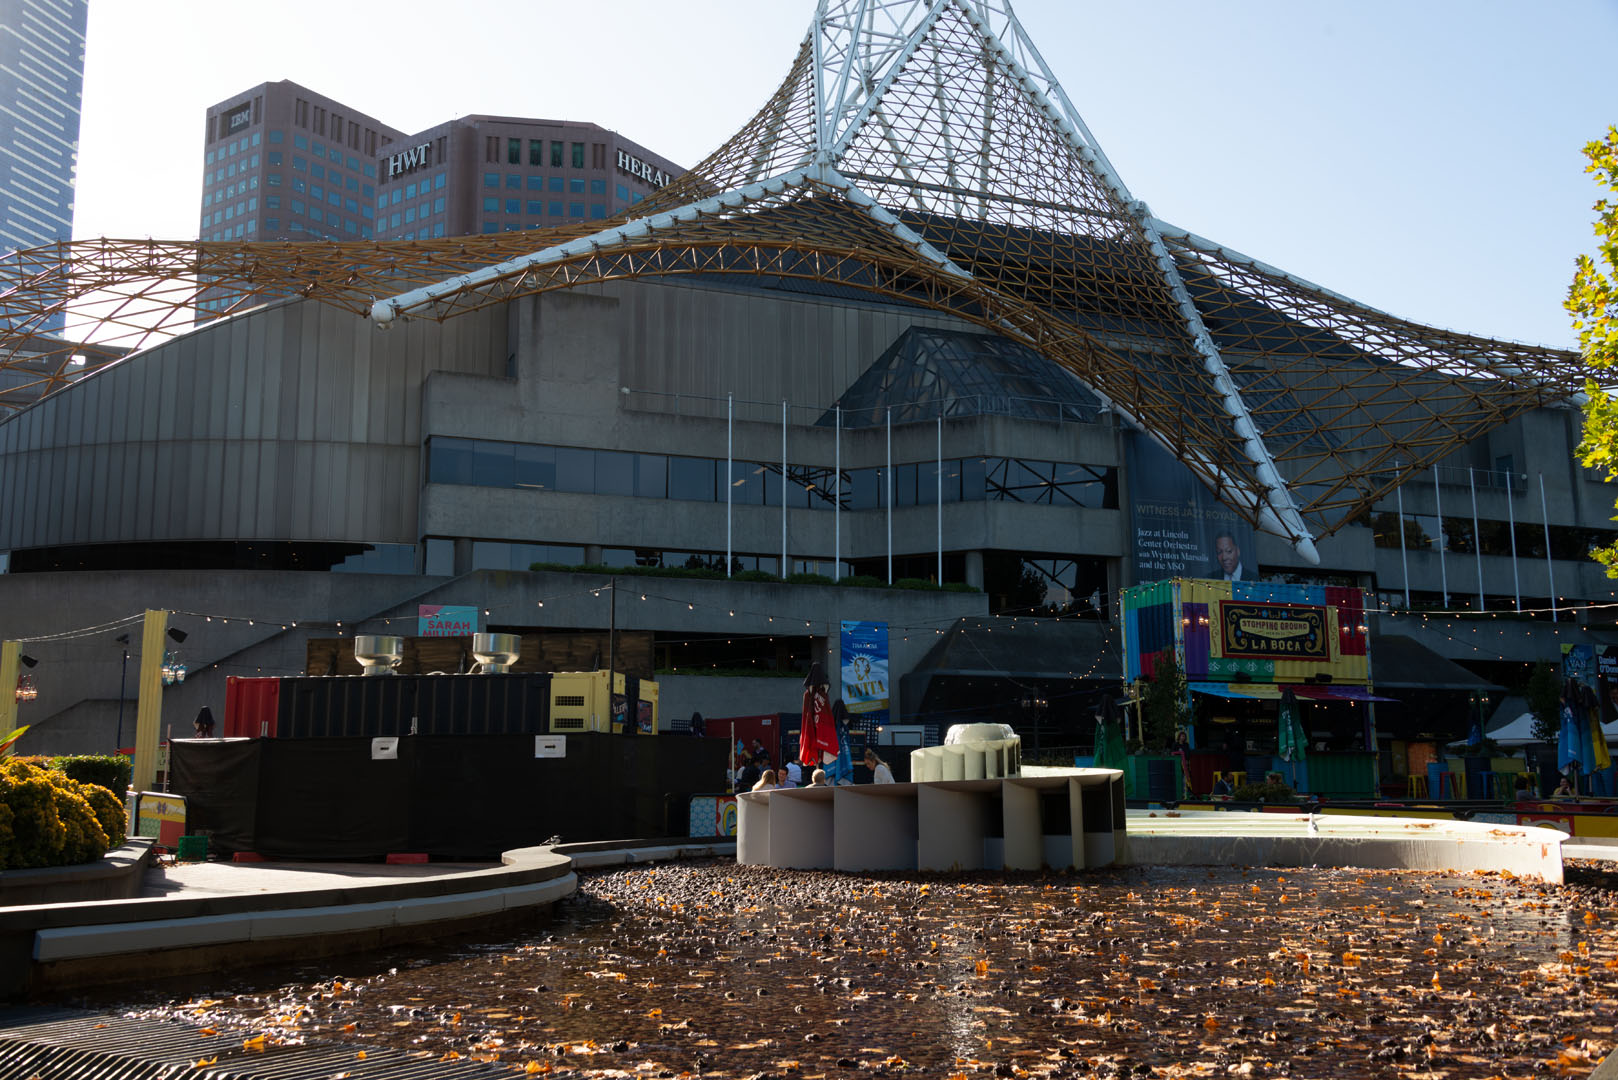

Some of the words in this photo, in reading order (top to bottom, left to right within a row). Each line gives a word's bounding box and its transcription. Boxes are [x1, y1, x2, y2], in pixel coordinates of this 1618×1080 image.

[388, 143, 430, 176] HWT
[1136, 503, 1179, 516] WITNESS
[1137, 528, 1152, 537] Jazz
[1153, 529, 1161, 537] at
[1162, 528, 1189, 539] Lincoln
[1138, 538, 1162, 548] Center
[1163, 539, 1198, 550] Orchestra
[1151, 550, 1179, 560] Wynton
[1139, 560, 1153, 569] and
[1154, 561, 1166, 569] the
[1167, 561, 1185, 571] MSO
[428, 621, 470, 630] SARAH
[1242, 620, 1278, 630] STOMPING
[1280, 623, 1307, 631] GROUND
[1251, 640, 1267, 649] LA
[1271, 641, 1301, 652] BOCA
[847, 680, 885, 698] EVITA
